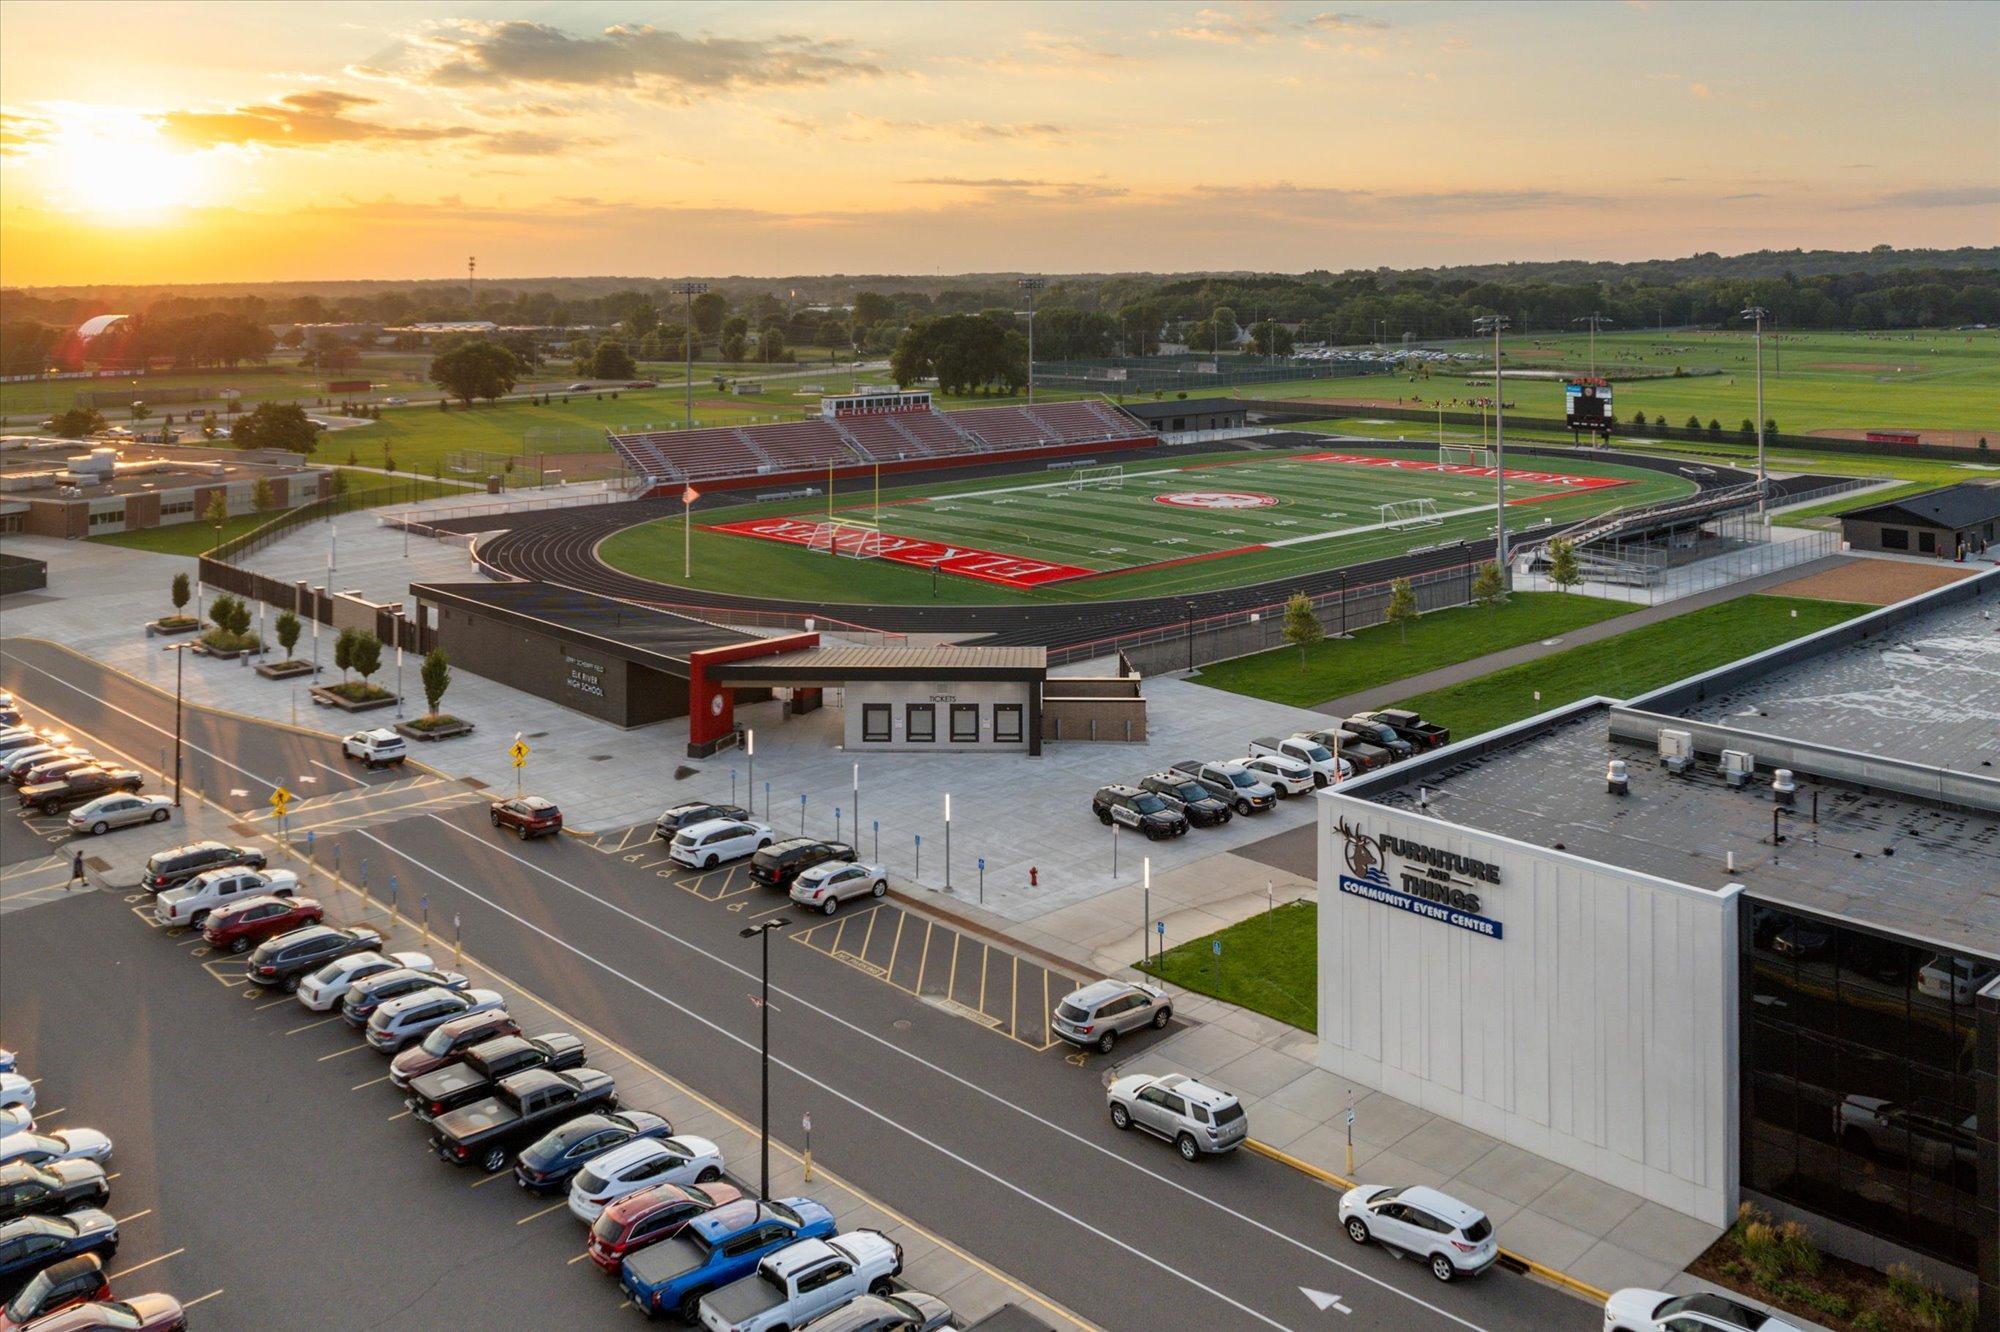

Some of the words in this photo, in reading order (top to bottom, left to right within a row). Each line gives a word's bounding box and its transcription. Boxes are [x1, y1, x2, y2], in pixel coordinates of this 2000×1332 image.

[904, 547, 1058, 578] ELK
[566, 677, 581, 689] HIGH
[581, 682, 604, 697] SCHOOL
[571, 669, 581, 679] ELK
[582, 672, 598, 685] RIVER
[929, 695, 957, 703] TICKETS
[1379, 833, 1501, 885] FURNITURE
[1426, 868, 1451, 883] AND
[1400, 872, 1481, 914] THINGS
[1343, 881, 1411, 910] COMMUNITY
[1413, 898, 1449, 922] EVENT
[1451, 913, 1494, 936] CENTER
